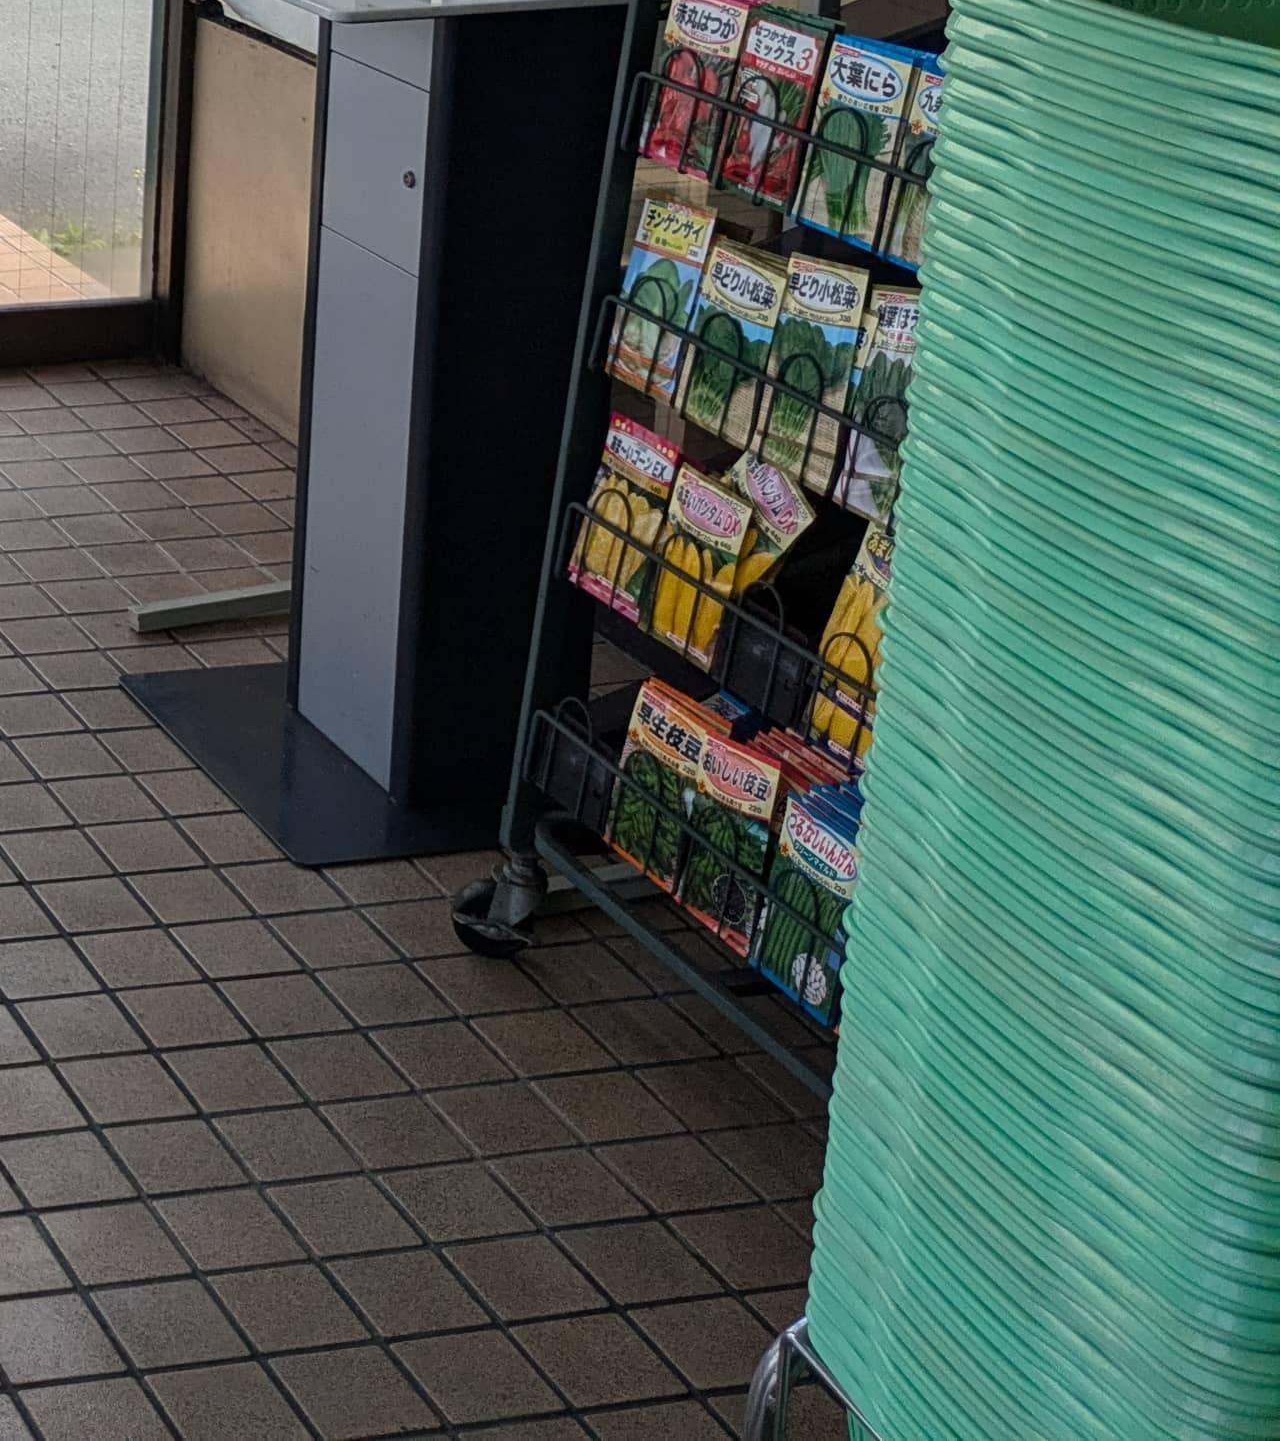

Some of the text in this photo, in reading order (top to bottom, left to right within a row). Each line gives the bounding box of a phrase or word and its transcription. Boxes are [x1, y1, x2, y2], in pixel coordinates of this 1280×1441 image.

[675, 2, 736, 40] 赤丸はつか
[754, 24, 798, 49] はつか大根
[831, 57, 897, 98] 大葉にら
[646, 208, 705, 244] チンゲンサイ
[711, 261, 777, 310] 早どり小松菜
[789, 272, 859, 310] 早どり小松菜
[637, 701, 703, 765] 早生枝豆
[702, 752, 771, 802] おいしい枝豆
[790, 812, 855, 877] つるなしいんげん
[793, 840, 835, 877] グリーンマイルド
